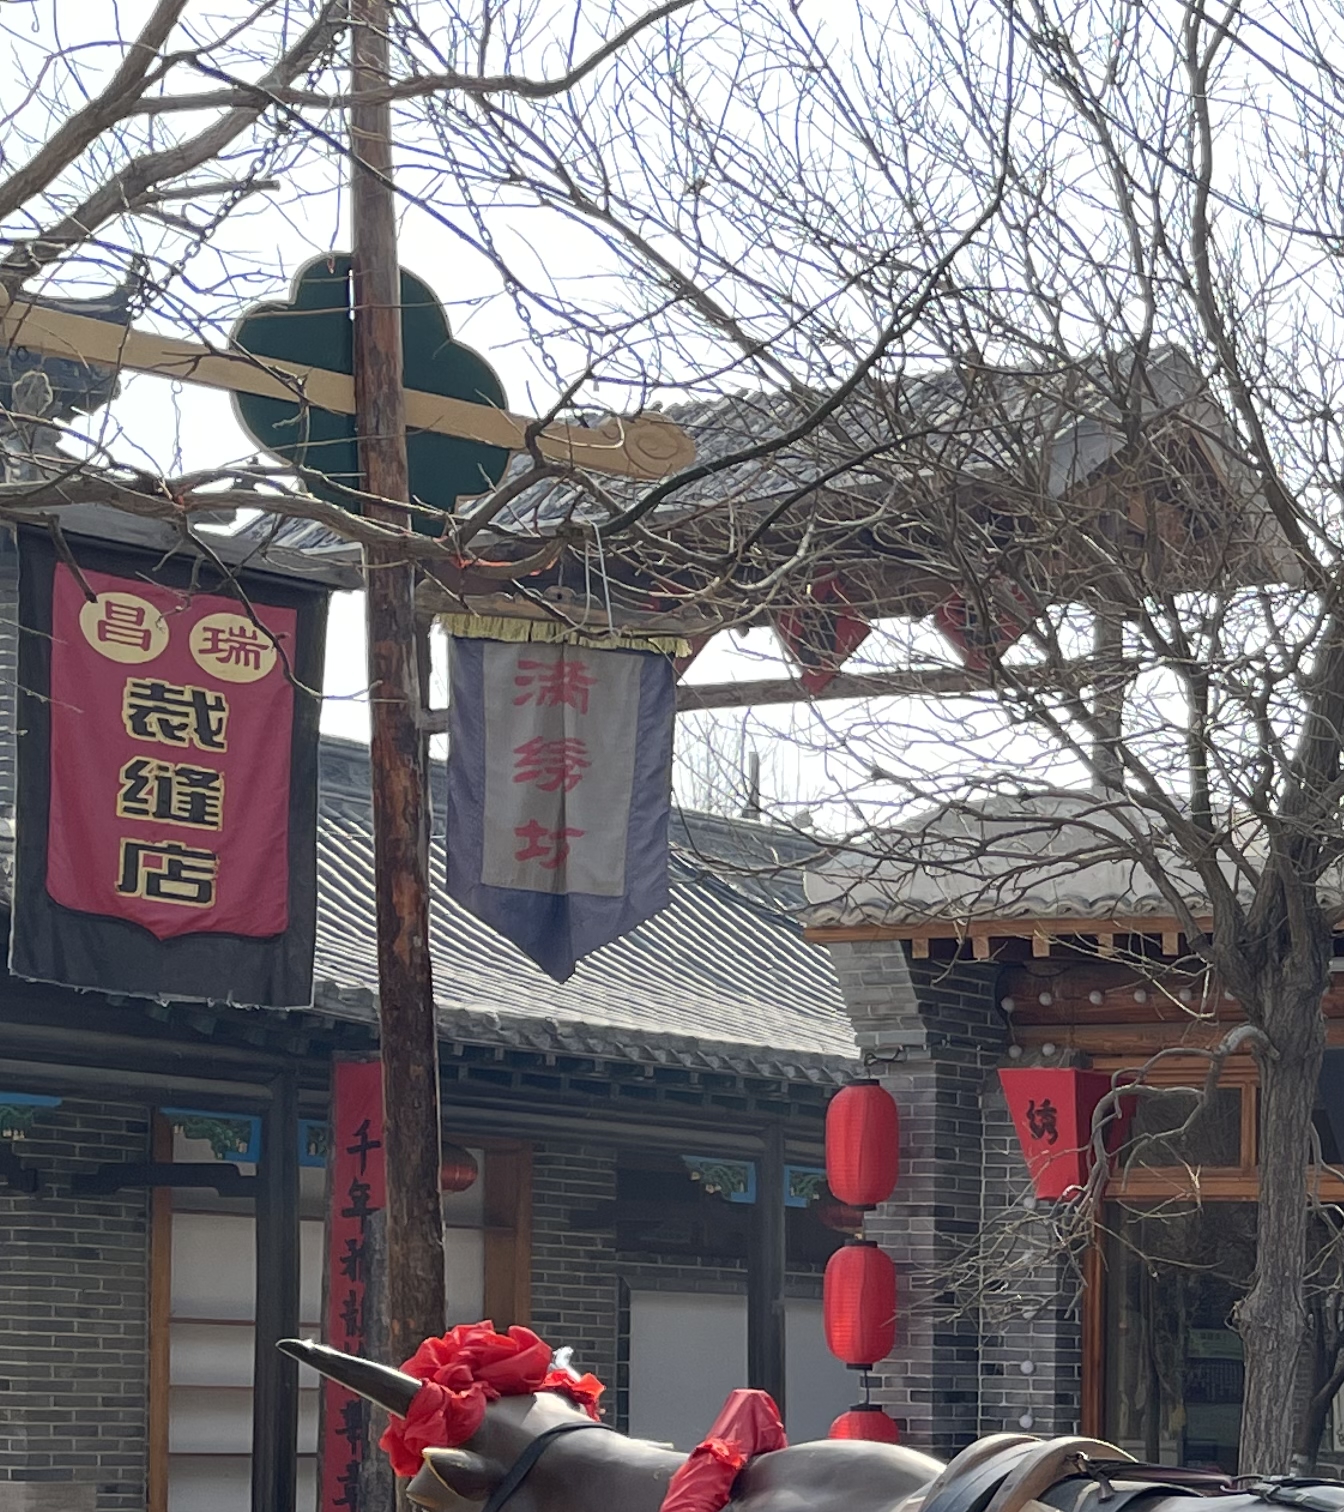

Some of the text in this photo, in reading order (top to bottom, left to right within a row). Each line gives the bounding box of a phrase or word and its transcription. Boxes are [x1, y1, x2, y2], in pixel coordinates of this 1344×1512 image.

[98, 600, 269, 671] 昌瑞
[116, 677, 228, 908] 裁缝店
[1026, 1098, 1058, 1145] 绣
